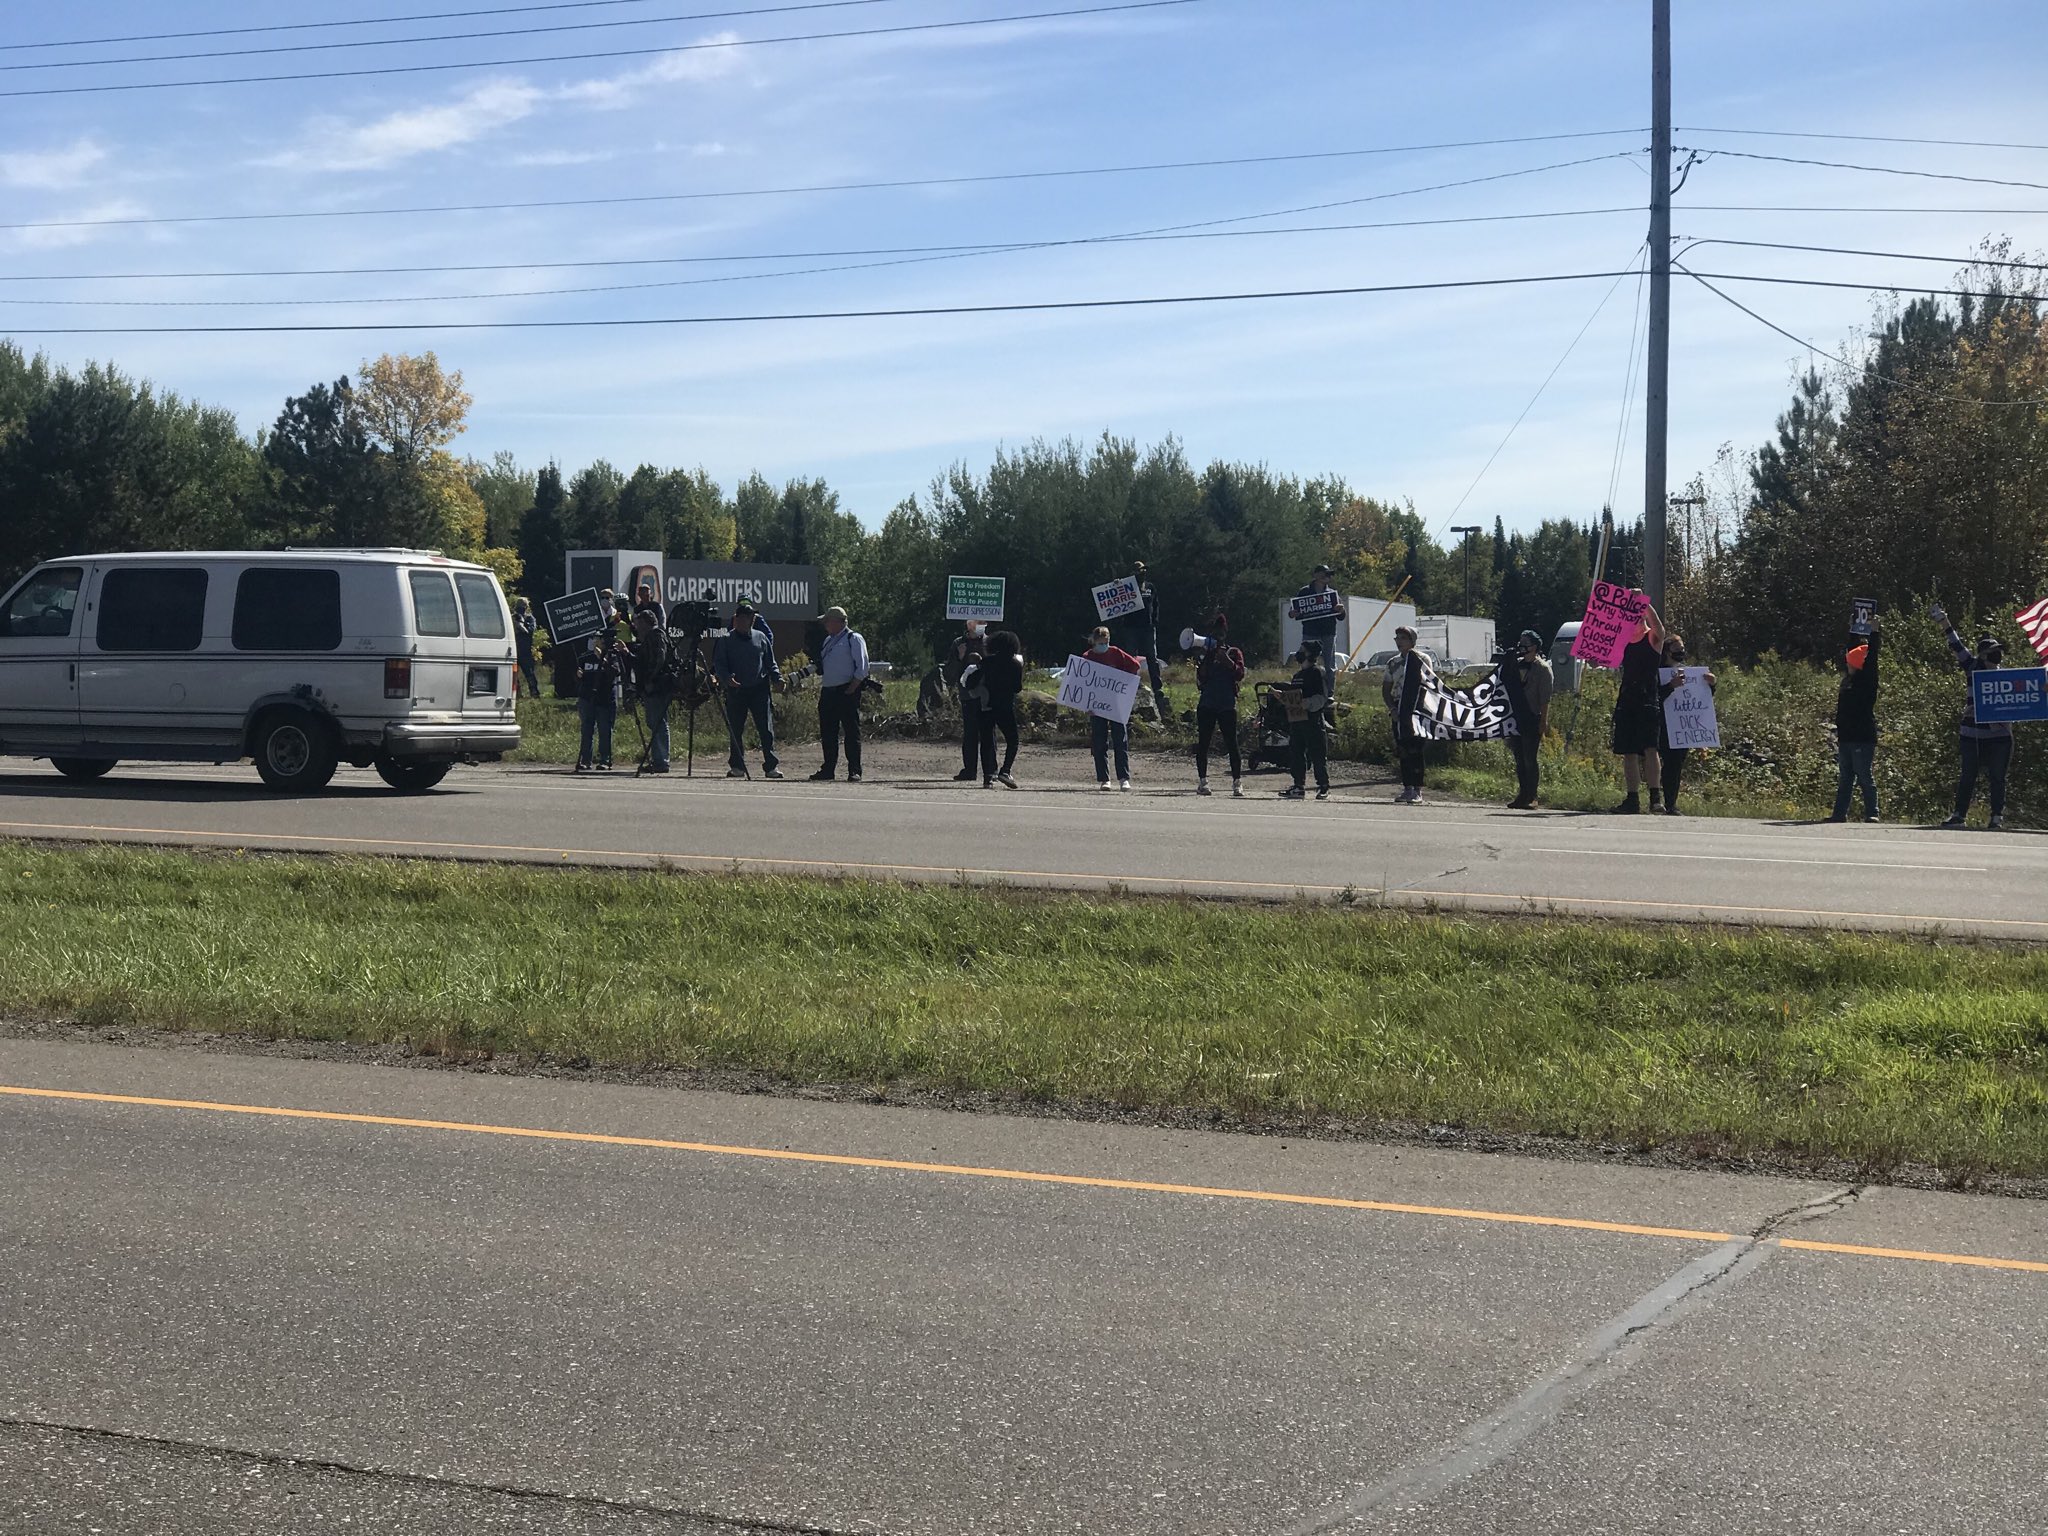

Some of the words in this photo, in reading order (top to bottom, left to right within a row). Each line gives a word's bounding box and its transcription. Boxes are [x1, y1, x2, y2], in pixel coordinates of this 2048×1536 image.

[667, 576, 762, 604] CARPENTERS
[767, 580, 809, 605] UNION
[974, 582, 1001, 590] Freedom
[976, 590, 999, 598] Justice
[1096, 582, 1134, 602] BIDEN
[977, 598, 998, 606] Peace
[1099, 591, 1137, 609] HARRIS
[1298, 594, 1331, 607] BIDEN
[1299, 602, 1333, 614] HARRIS
[1612, 588, 1648, 613] Police
[554, 606, 572, 615] There
[572, 602, 583, 610] can
[571, 609, 589, 620] peace
[949, 606, 956, 614] NO
[957, 606, 969, 615] VOTE
[1106, 601, 1136, 617] 2020
[1592, 600, 1617, 620] Why
[557, 620, 579, 631] without
[579, 614, 598, 626] justice
[1582, 626, 1618, 647] Closed
[1066, 658, 1091, 678] NO
[1085, 670, 1129, 695] JUSTICE
[1981, 679, 2039, 694] BIDEN
[1062, 684, 1083, 704] NO
[1086, 691, 1113, 712] Peace
[1673, 697, 1708, 712] little
[1982, 692, 2040, 705] HARRIS
[1415, 685, 1511, 728] LIVES
[1411, 714, 1521, 741] MATTER
[1679, 714, 1707, 730] DICK
[1674, 729, 1717, 745] ENERGY
